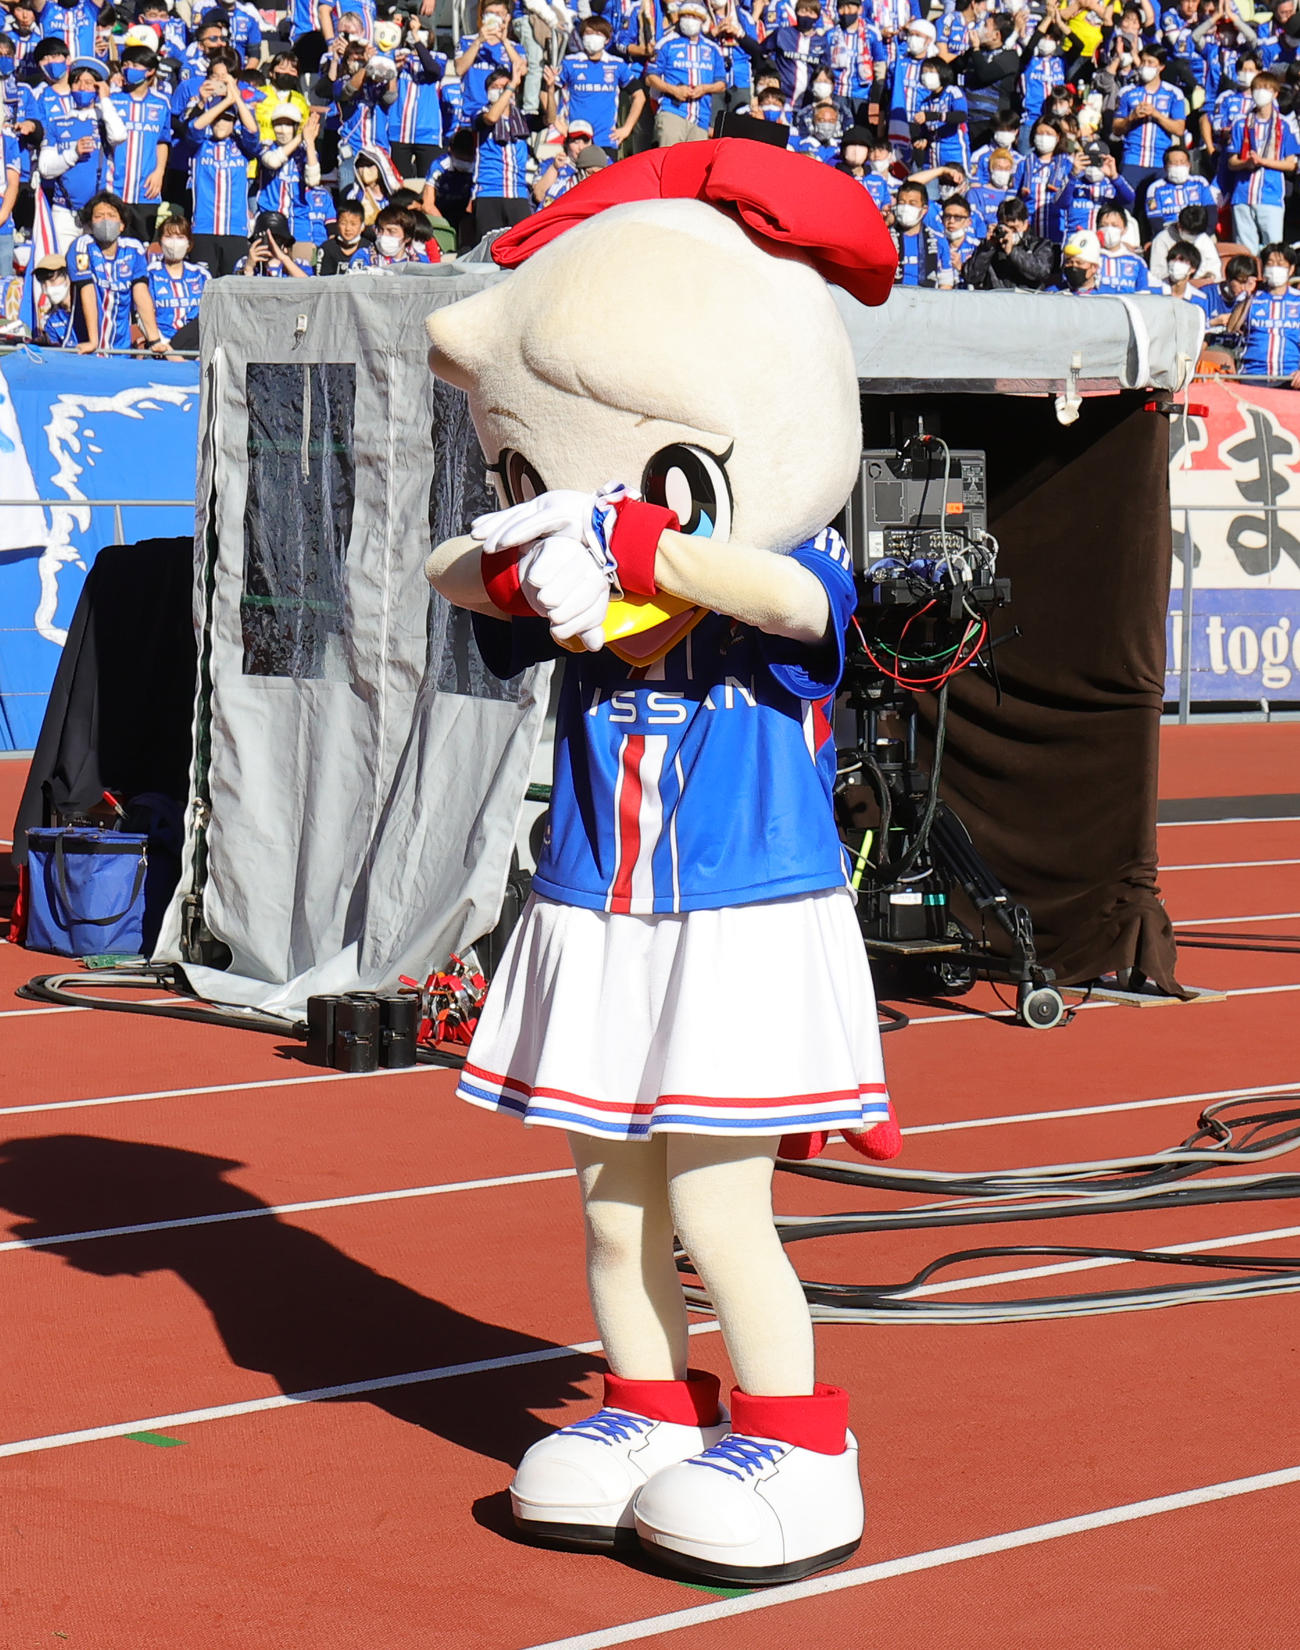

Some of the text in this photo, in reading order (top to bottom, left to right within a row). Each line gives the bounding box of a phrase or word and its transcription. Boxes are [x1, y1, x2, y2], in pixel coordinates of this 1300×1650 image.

[673, 60, 713, 71] NISSAN
[574, 84, 618, 92] NISSAN
[201, 157, 245, 168] NISSAN
[1250, 318, 1299, 329] NISSAN
